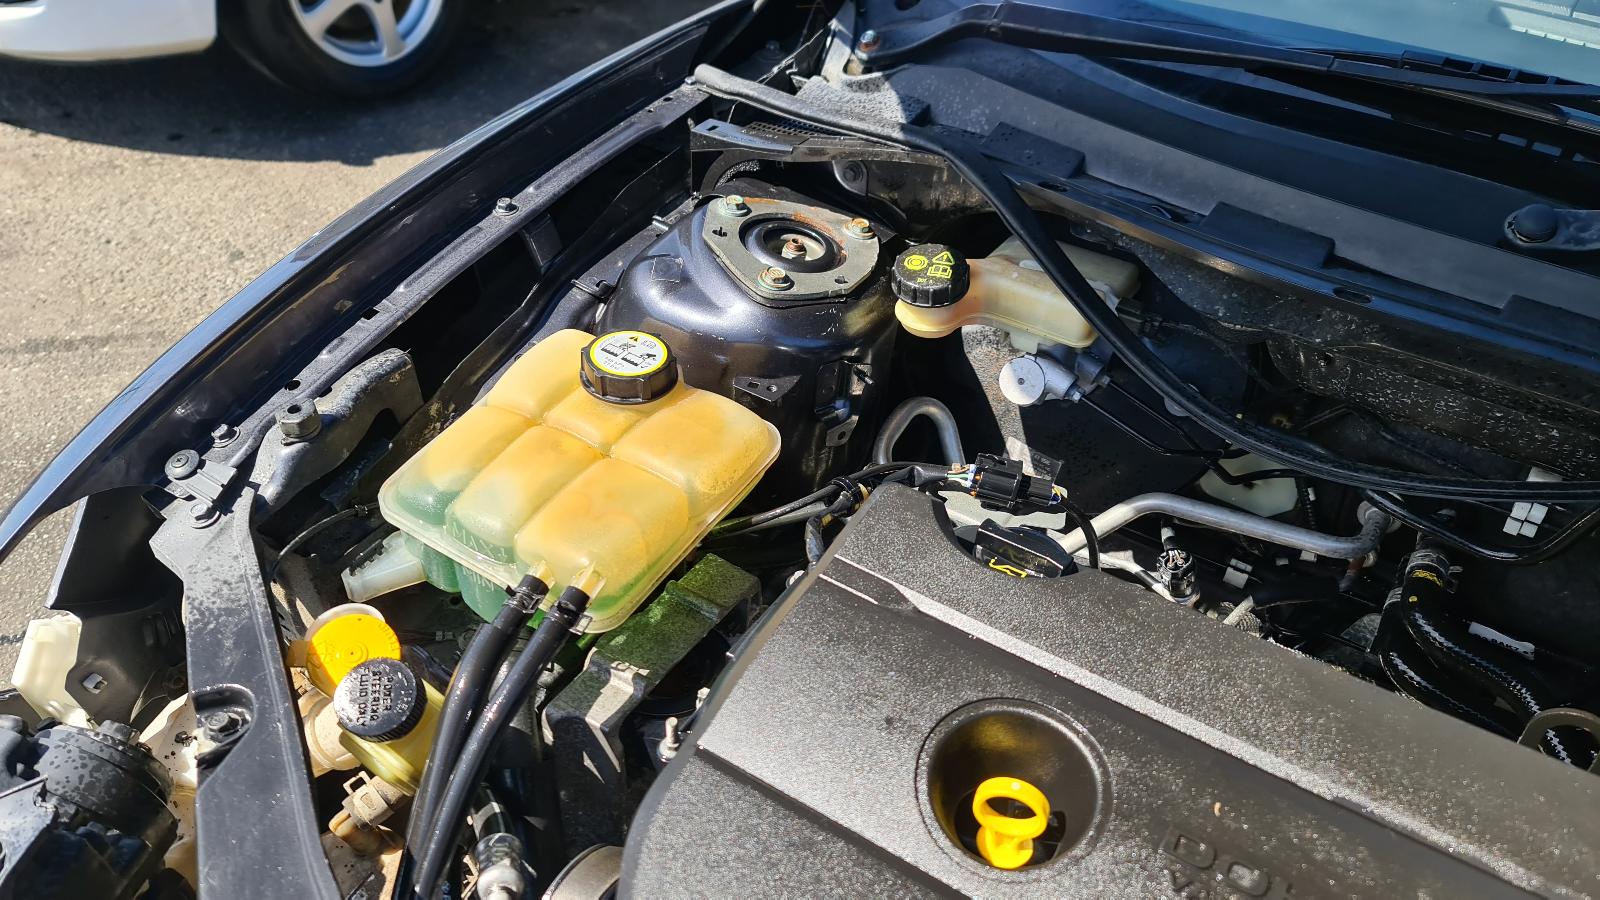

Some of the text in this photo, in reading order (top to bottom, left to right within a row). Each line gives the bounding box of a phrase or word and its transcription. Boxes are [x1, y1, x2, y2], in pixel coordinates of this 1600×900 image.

[356, 666, 370, 727] FLUID ONLY
[369, 670, 382, 722] STEERING
[383, 675, 394, 711] POWER
